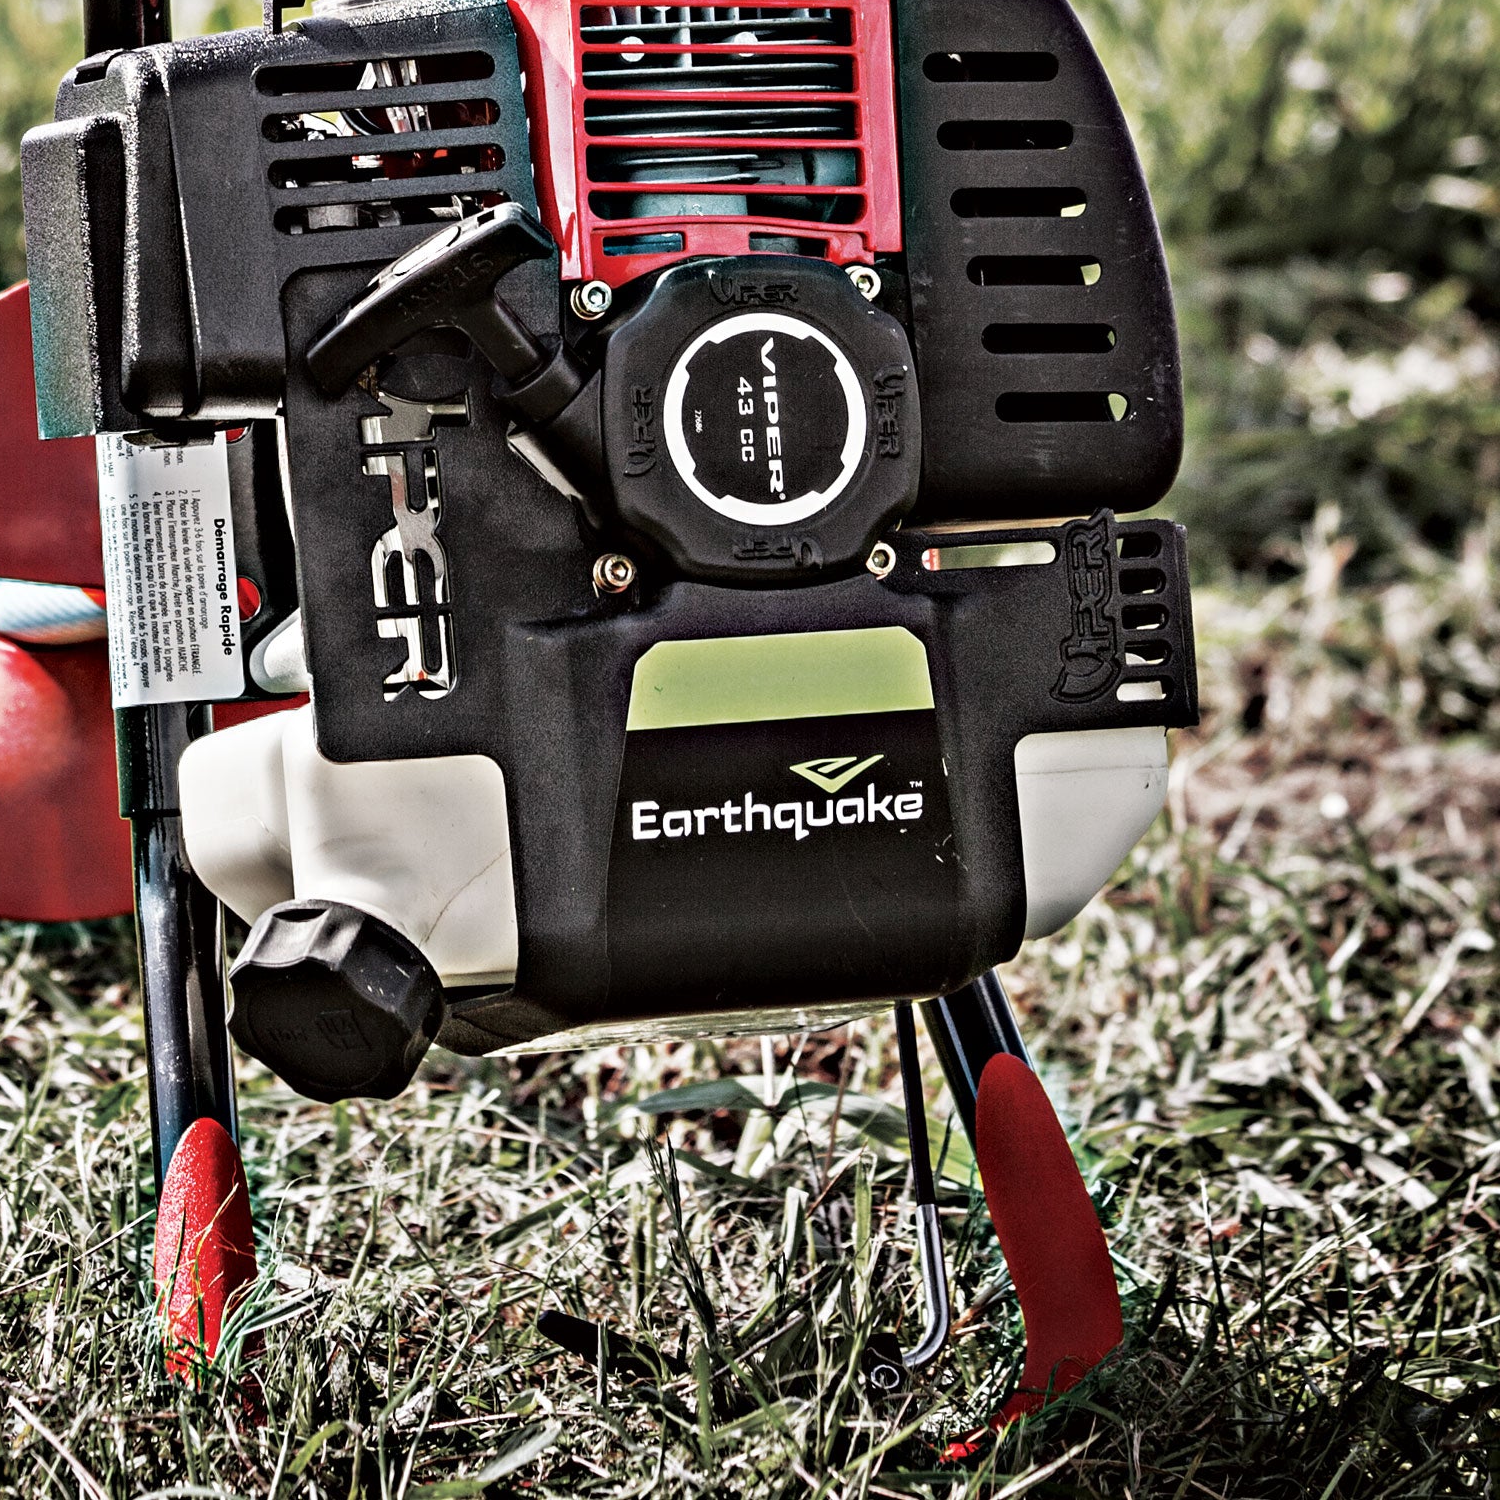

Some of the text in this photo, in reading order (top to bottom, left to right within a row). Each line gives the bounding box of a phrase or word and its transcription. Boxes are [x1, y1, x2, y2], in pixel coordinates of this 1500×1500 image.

[737, 376, 754, 416] 43
[761, 337, 784, 494] VIPER
[141, 501, 150, 510] du
[153, 500, 162, 515] Tenir
[166, 499, 176, 518] Placer
[179, 498, 189, 517] Placer
[191, 497, 202, 524] Appuyez
[130, 519, 139, 542] moteur
[154, 517, 165, 552] fermement
[359, 350, 471, 702] IPER
[181, 527, 191, 545] levier
[132, 543, 139, 551] ne
[143, 538, 154, 562] Répéter
[182, 546, 191, 555] du
[194, 540, 204, 552] fois
[133, 553, 143, 580] démarre
[183, 556, 193, 572] volet
[195, 554, 203, 563] sur
[157, 562, 167, 579] barre
[184, 574, 194, 582] de
[134, 581, 143, 593] pas
[158, 581, 168, 589] de
[184, 584, 195, 604] départ
[211, 517, 236, 655] Démarrage Rapide
[136, 605, 146, 619] bout
[148, 599, 156, 611] que
[174, 609, 181, 617] en
[187, 606, 194, 614] en
[138, 621, 147, 629] de
[151, 620, 159, 643] moteur
[162, 621, 171, 634] Tirer
[173, 619, 185, 644] position
[186, 617, 198, 642] position
[140, 661, 149, 688] appuyer
[162, 655, 174, 682] poignée
[632, 782, 923, 841] Earthquake
